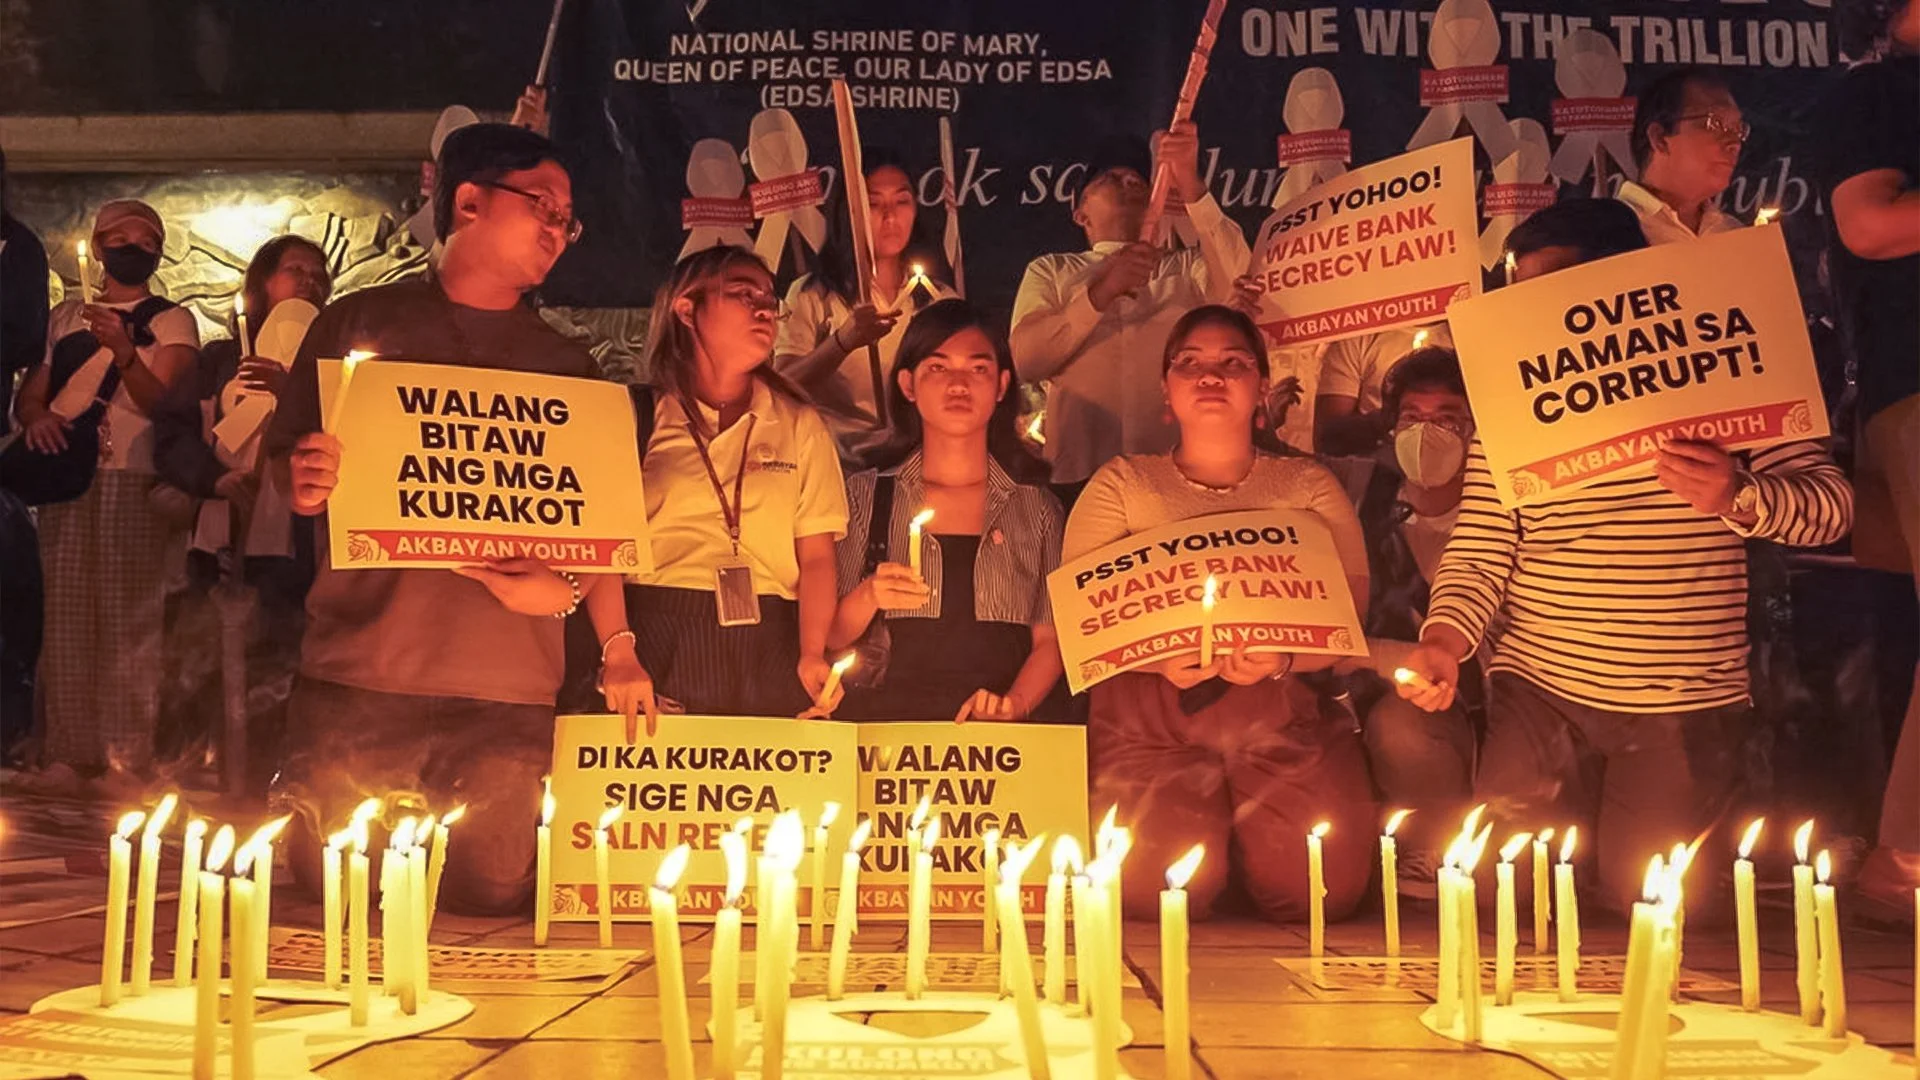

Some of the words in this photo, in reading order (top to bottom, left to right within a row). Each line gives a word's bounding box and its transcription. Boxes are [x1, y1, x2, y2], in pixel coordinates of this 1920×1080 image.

[670, 29, 804, 56] NATIONAL
[813, 30, 914, 52] SHRINE
[922, 31, 956, 53] OF
[963, 33, 1047, 57] MARY,
[1241, 8, 1338, 57] ONE
[1611, 17, 1829, 67] TRILLION
[614, 59, 701, 84] QUEEN
[710, 60, 744, 81] OF
[854, 58, 911, 80] OUR
[919, 59, 989, 84] LADY
[997, 61, 1032, 82] OF
[1040, 59, 1112, 83] EDSA
[851, 86, 960, 112] SHRINE)
[1267, 200, 1323, 240] PSST
[1329, 166, 1442, 215] YOHOO!
[1266, 225, 1350, 264] WAIVE
[1356, 203, 1437, 243] BANK
[1250, 249, 1372, 296] SECRECY
[1381, 230, 1457, 268] LAW!
[1281, 309, 1369, 339] AKBAYAN
[1372, 295, 1437, 321] YOUTH
[1564, 282, 1682, 335] OVER
[1518, 318, 1689, 390] NAMAN
[1695, 307, 1757, 343] SA
[1533, 341, 1765, 425] CORRUPT!
[397, 386, 569, 426] WALANG
[420, 421, 546, 457] BITAW
[1554, 429, 1675, 480] AKBAYAN
[1680, 413, 1766, 441] YOUTH
[397, 454, 486, 486] ANG
[494, 459, 583, 493] MGA
[399, 489, 585, 527] KURAKOT
[396, 536, 515, 558] AKBAYAN
[518, 541, 597, 562] YOUTH
[1075, 546, 1152, 590] PSST
[1159, 525, 1299, 557] YOHOO!
[1087, 560, 1199, 610] WAIVE
[1205, 554, 1302, 576] BANK
[1080, 580, 1230, 636] SECRECY
[1240, 580, 1328, 601] LAW!
[1236, 627, 1314, 643] YOUTH
[577, 746, 607, 769] DI
[614, 746, 659, 769] KA
[665, 747, 833, 773] KURAKOT?
[857, 745, 1022, 773] WALANG
[604, 783, 688, 812] SIGE
[874, 779, 997, 805] BITAW
[939, 811, 1028, 840] MGA
